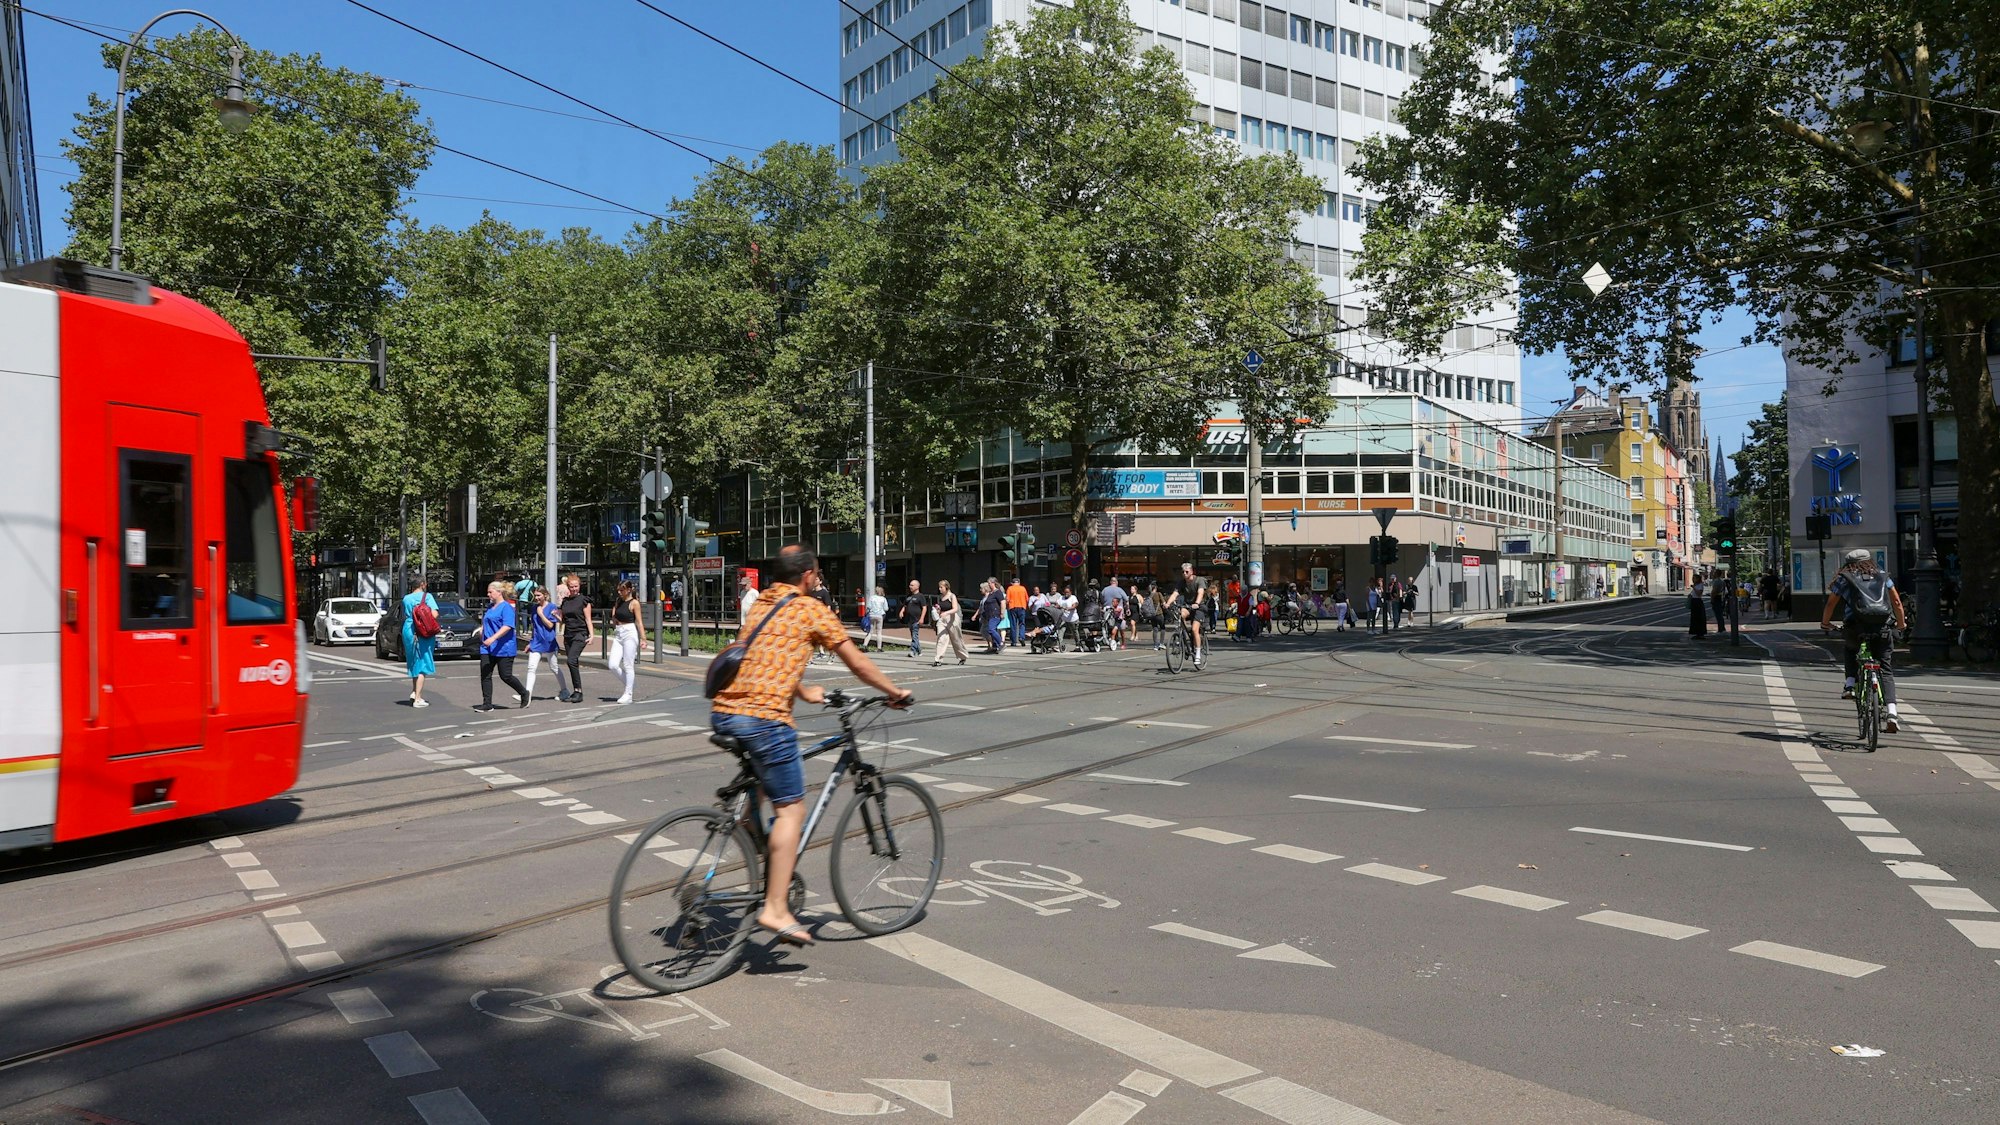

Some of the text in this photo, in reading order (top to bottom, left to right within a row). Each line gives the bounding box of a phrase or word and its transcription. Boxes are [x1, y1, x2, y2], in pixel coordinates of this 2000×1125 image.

[1125, 474, 1146, 483] FOR
[1100, 484, 1160, 494] EVERYBODY
[1318, 500, 1346, 509] KURSE
